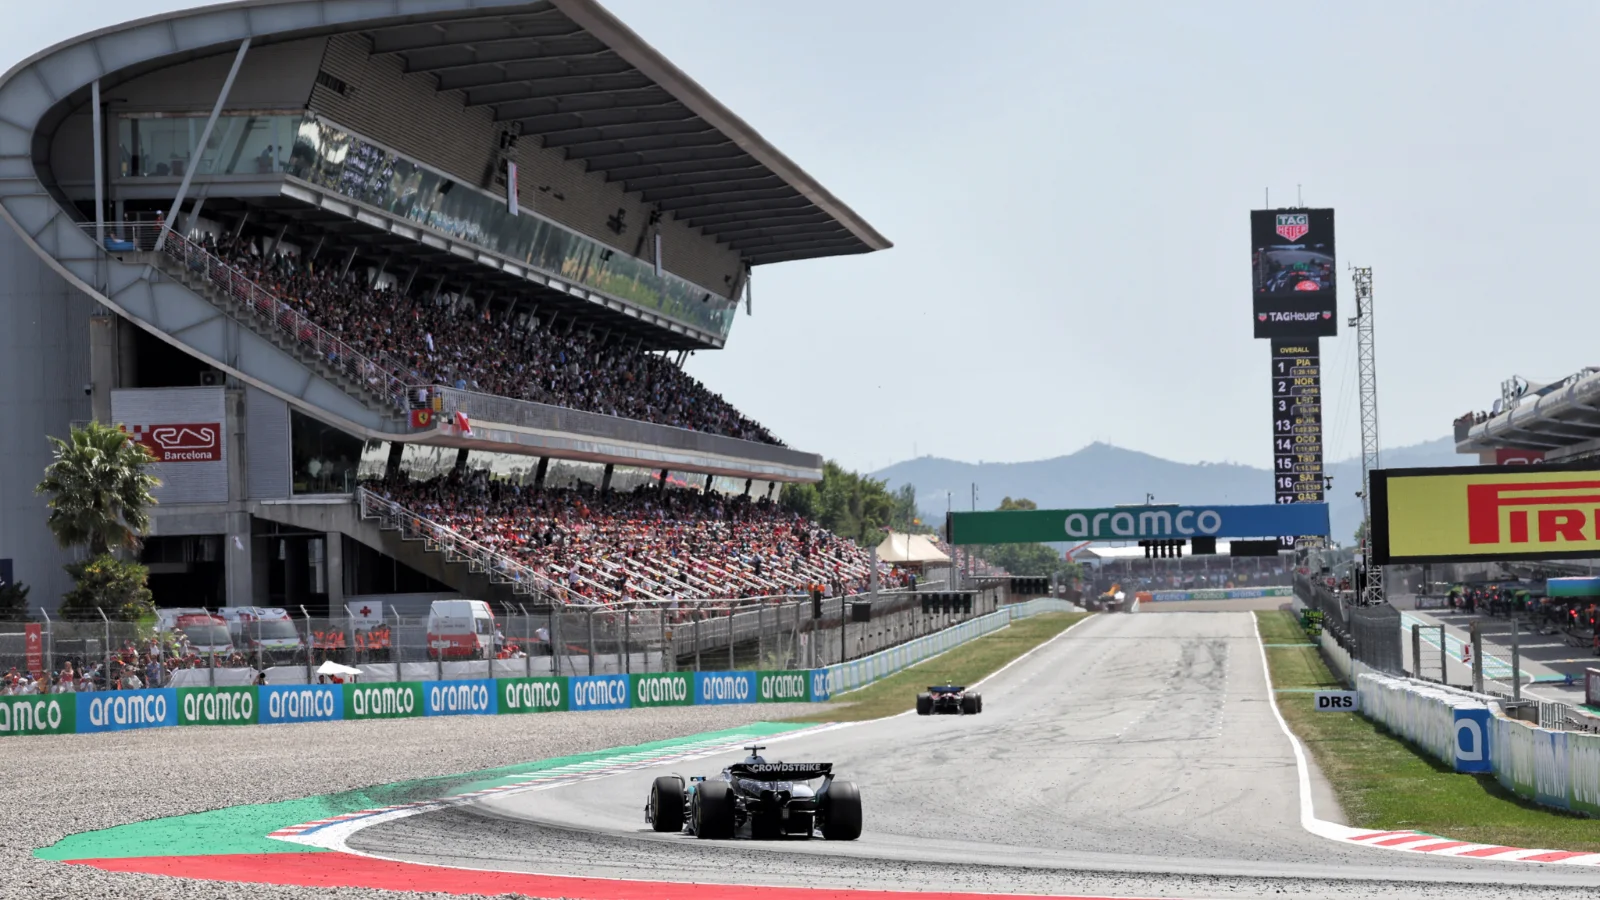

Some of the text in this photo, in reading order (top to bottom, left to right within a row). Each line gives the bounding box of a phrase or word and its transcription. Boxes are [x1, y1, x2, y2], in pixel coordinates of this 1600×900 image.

[1279, 215, 1306, 225] TAG
[1277, 226, 1307, 238] HEUER
[1278, 362, 1284, 373] 1
[1278, 381, 1286, 392] 2
[1278, 400, 1287, 411] 3
[1276, 419, 1291, 431] 13
[1276, 439, 1291, 450] 14
[164, 451, 212, 460] Barcelona
[1277, 458, 1292, 469] 15
[1277, 477, 1292, 488] 16
[1299, 474, 1315, 482] SAI
[1278, 496, 1293, 504] 17
[1467, 482, 1600, 544] PIR
[1064, 510, 1222, 537] aramco
[574, 679, 626, 705] aramco
[637, 677, 687, 702] aramco
[702, 676, 749, 700] aramco
[761, 675, 804, 698] aramco
[352, 682, 415, 715] aramco
[430, 684, 489, 711] aramco
[505, 682, 560, 708] aramco
[1319, 696, 1353, 708] DRS
[90, 694, 167, 726] aramco
[184, 692, 252, 721] aramco
[269, 689, 334, 719] aramco
[752, 763, 821, 772] CROWDSTRIKE
